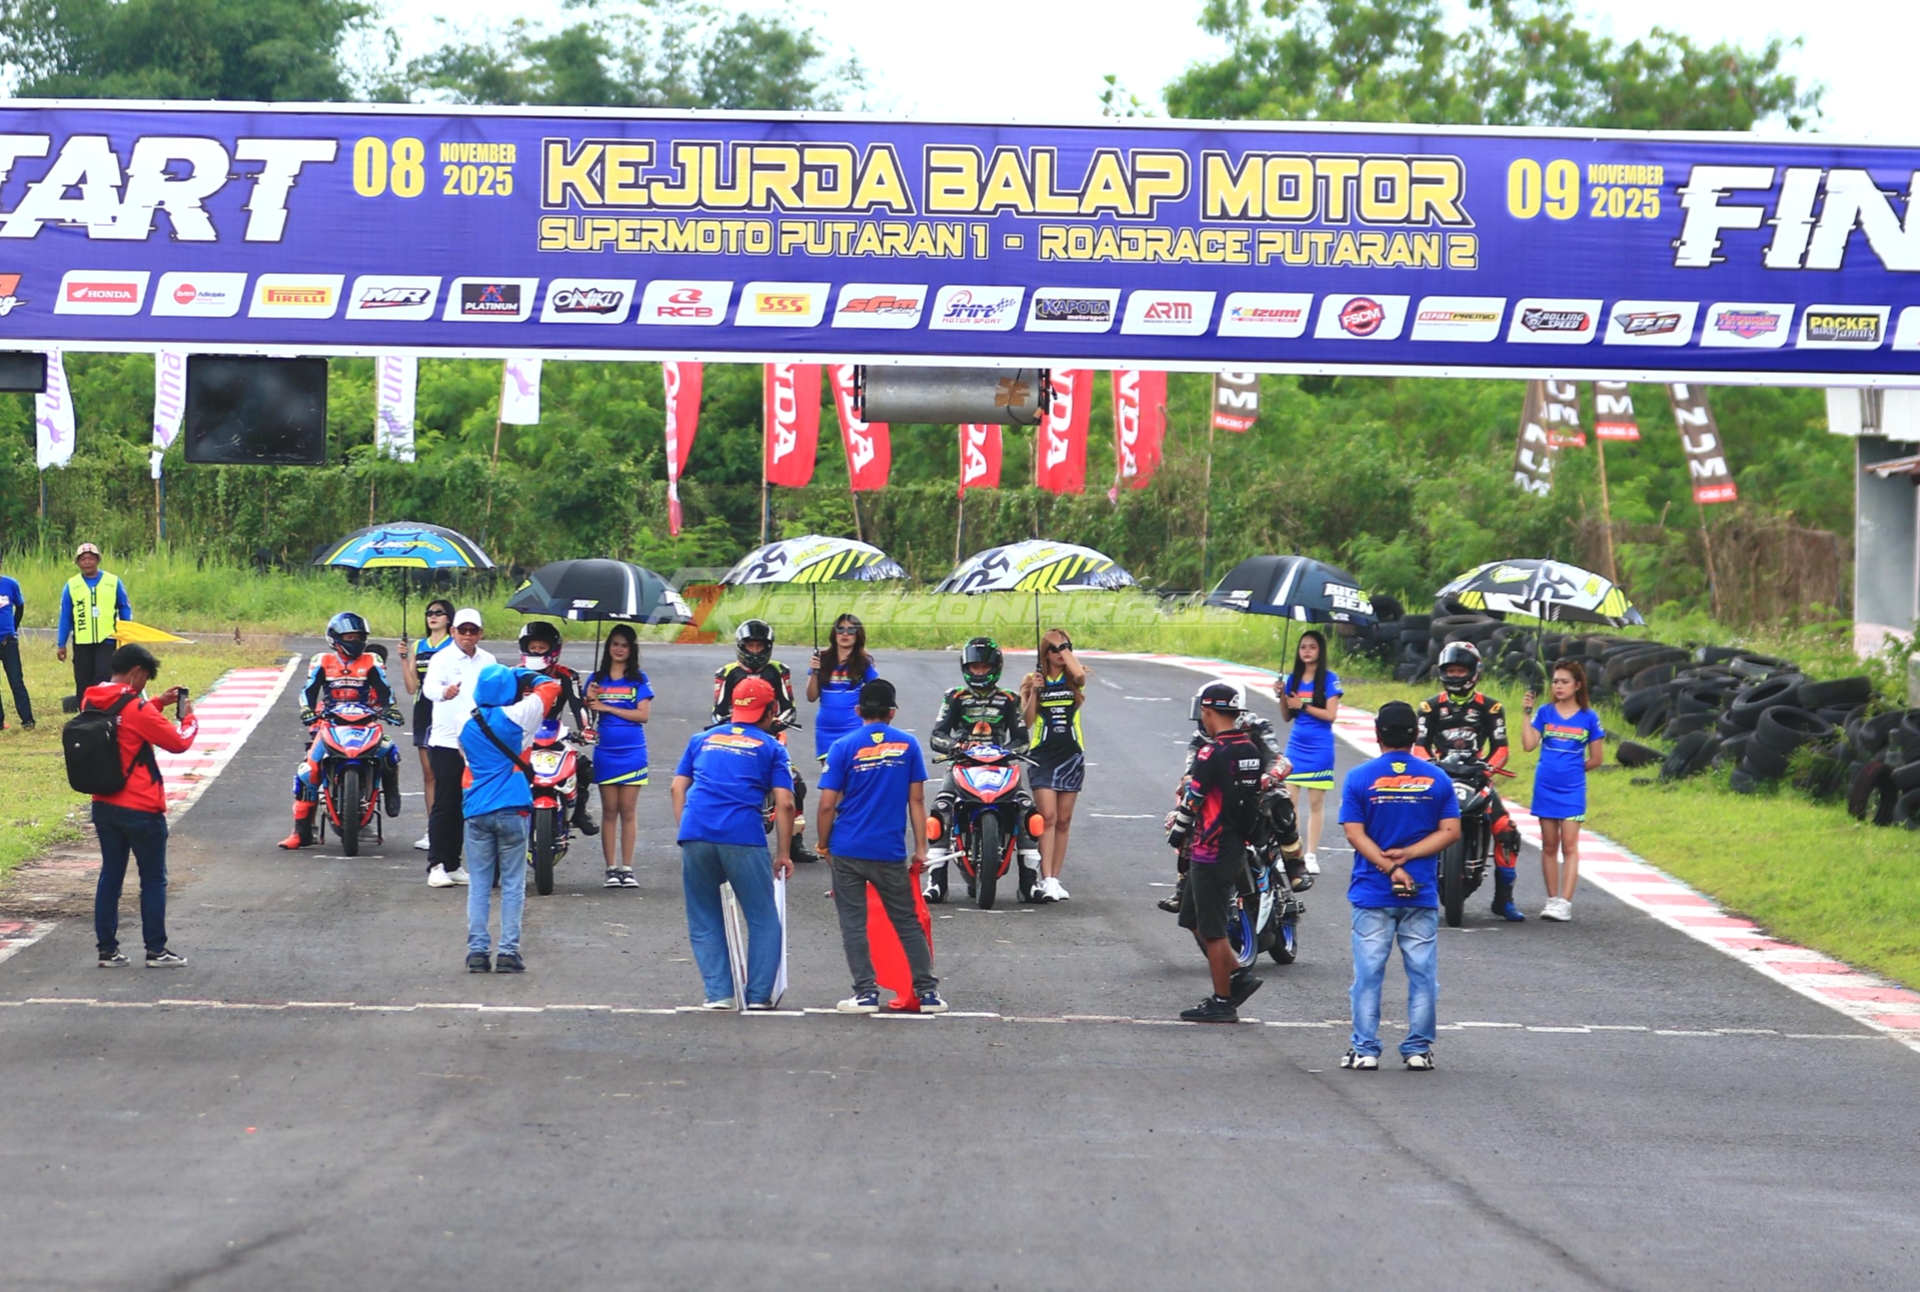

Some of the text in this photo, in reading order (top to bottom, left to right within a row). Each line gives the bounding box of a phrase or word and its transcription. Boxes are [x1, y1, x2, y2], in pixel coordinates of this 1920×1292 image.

[440, 142, 517, 164] NOVEMBER
[352, 136, 426, 199] 08
[1588, 163, 1665, 186] NOVEMBER
[443, 164, 514, 198] 2025
[541, 136, 1476, 228] KEJURDA BALAP MOTOR
[1507, 158, 1581, 221] 09
[1590, 187, 1661, 220] 2025
[538, 216, 1479, 270] SUPERMOTO PUTARAN 1 - ROADRACE PUTARAN 2
[87, 290, 132, 299] HONDA
[268, 289, 326, 303] PIRELLI
[465, 302, 518, 311] PLATINUM
[657, 306, 714, 318] RCB
[1041, 299, 1110, 315] KAPOTA
[1143, 302, 1193, 320] ARM
[1067, 314, 1110, 322] motorsport
[1343, 307, 1381, 327] FSCM
[1419, 312, 1496, 320] ASPIRA PREMIO
[1543, 313, 1585, 321] ROLLING
[1547, 320, 1579, 329] SPEED
[1810, 316, 1878, 330] POCKET
[1332, 594, 1375, 616] BEN
